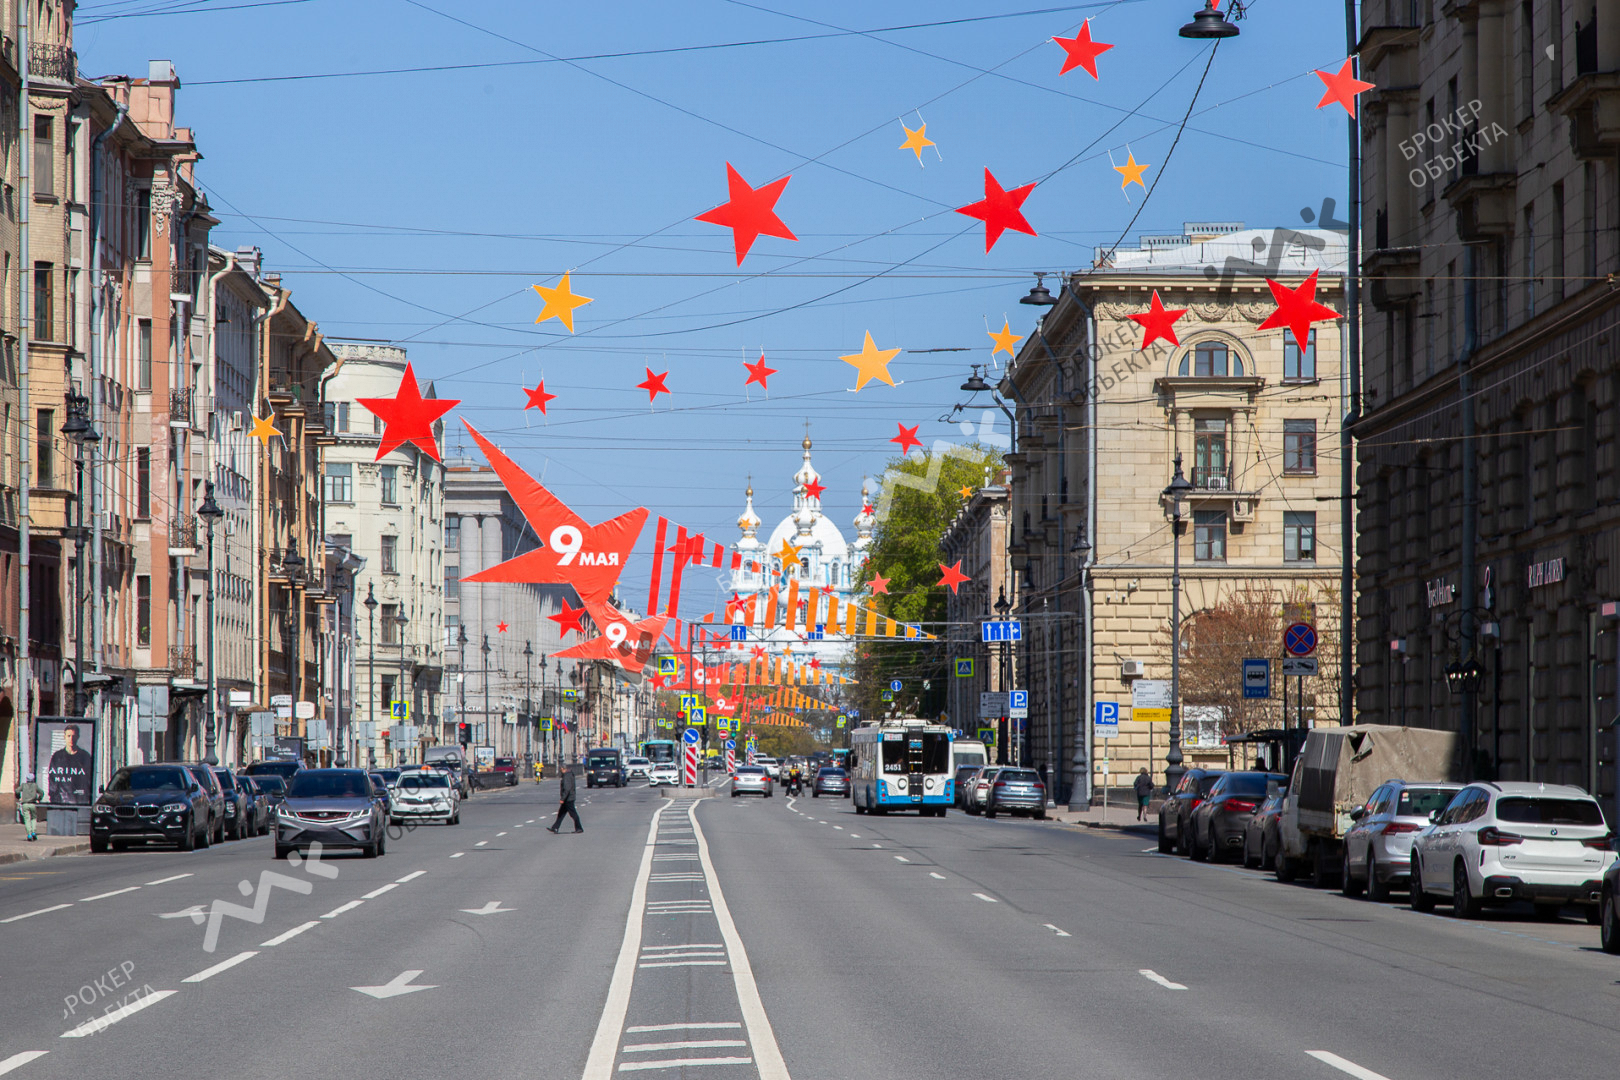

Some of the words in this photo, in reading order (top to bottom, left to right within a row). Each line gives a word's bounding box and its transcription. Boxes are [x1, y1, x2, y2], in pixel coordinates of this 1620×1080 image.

[549, 525, 583, 566] 9
[579, 551, 619, 567] МАЯ
[605, 622, 628, 649] 9
[623, 639, 650, 650] МАЯ
[42, 766, 86, 776] ZARINA
[884, 763, 902, 771] 2451
